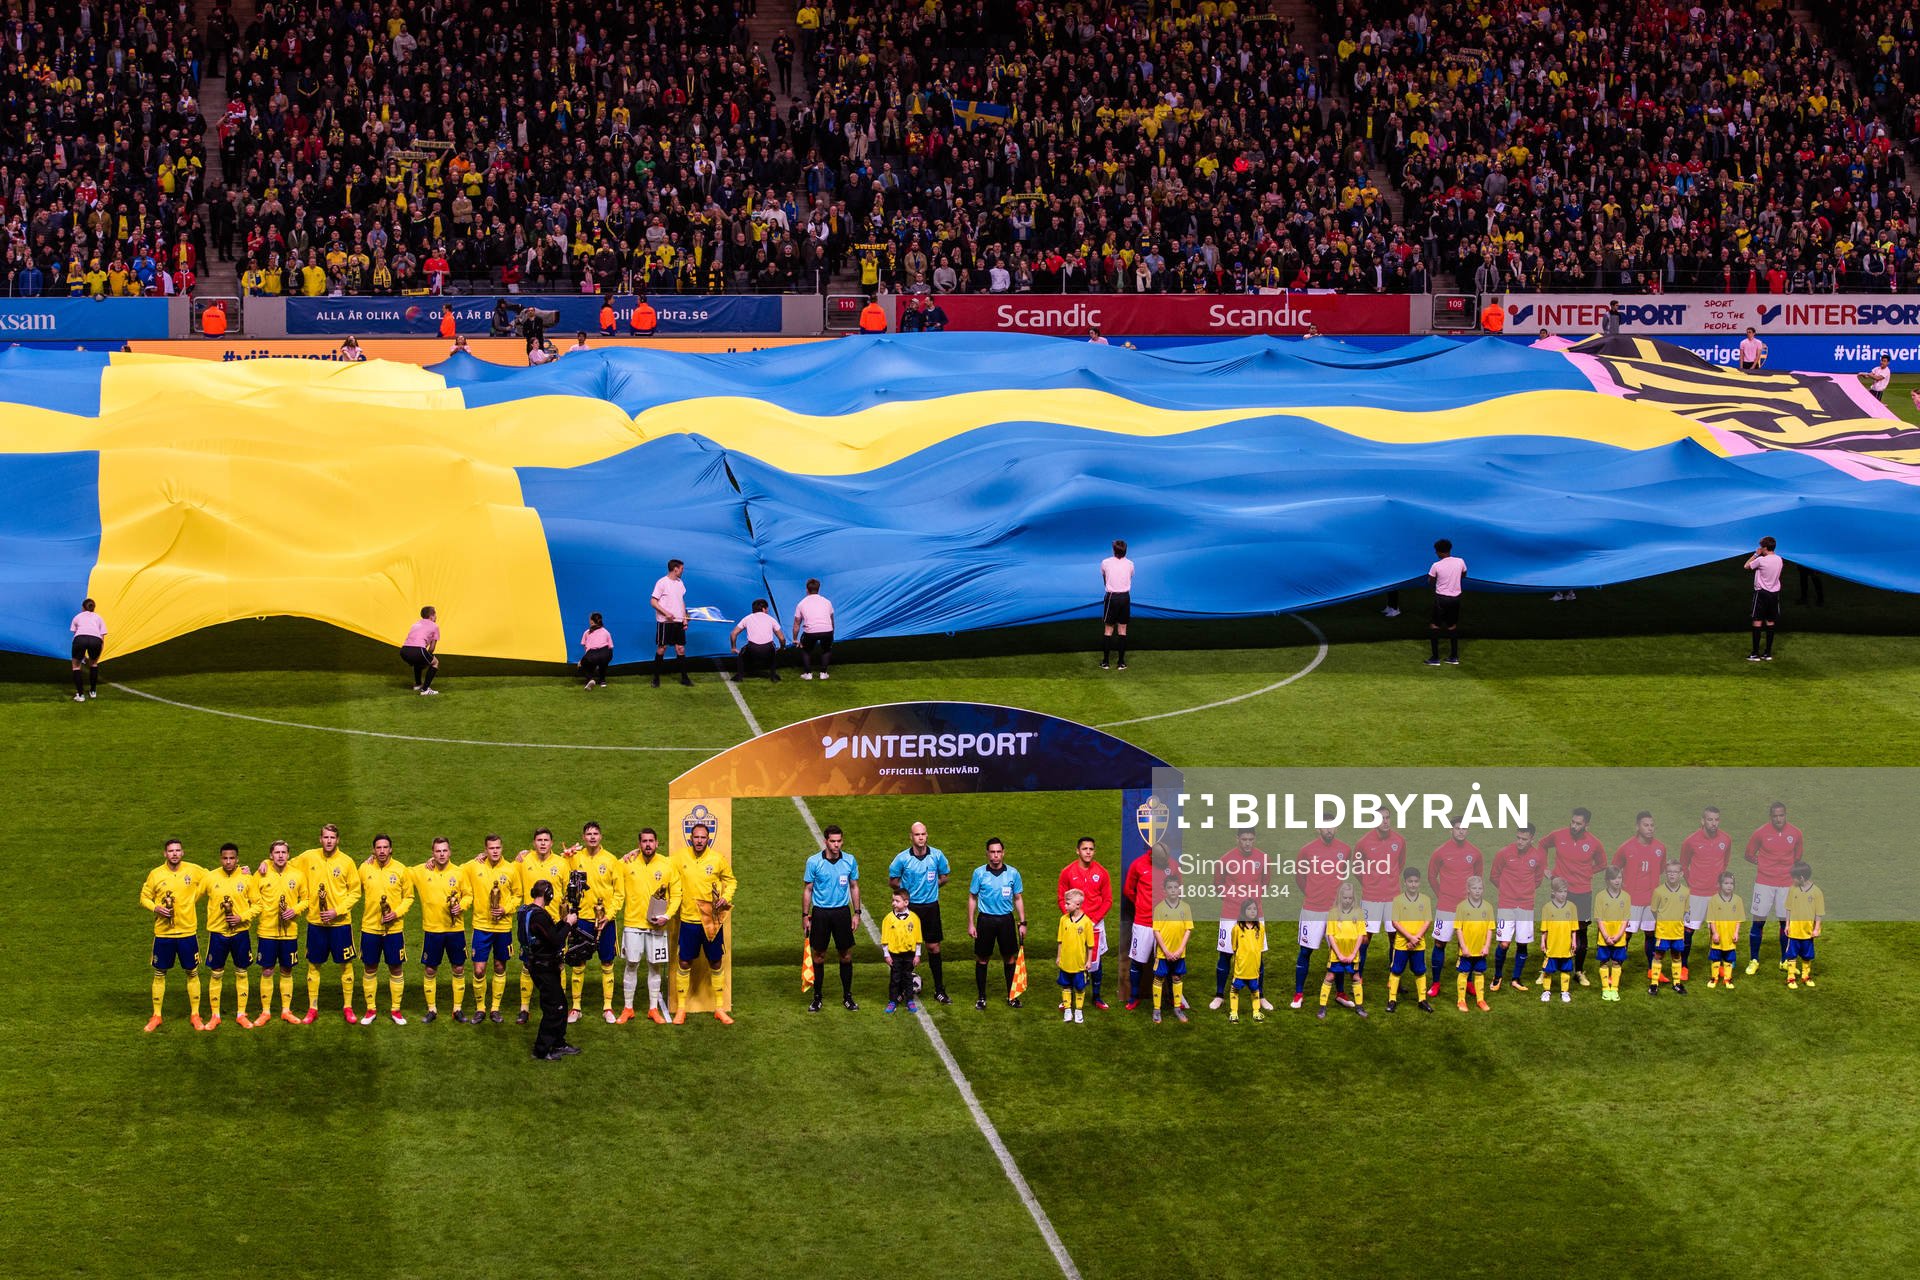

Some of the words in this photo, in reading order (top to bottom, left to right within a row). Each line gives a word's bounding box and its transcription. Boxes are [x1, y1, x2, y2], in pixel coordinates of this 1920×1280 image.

[839, 300, 855, 309] 110
[1449, 300, 1462, 308] 109
[1704, 299, 1735, 308] SPORT
[316, 311, 345, 320] ALLA
[348, 309, 363, 320] ÄR
[366, 311, 400, 320] OLIKA
[429, 311, 463, 320] OLA
[466, 309, 481, 320] ÄR
[997, 303, 1101, 328] Scandic
[1209, 303, 1312, 327] Scandic
[1710, 311, 1724, 319] TO
[1727, 311, 1745, 319] THE
[1704, 322, 1737, 330] PEOPLE
[1691, 344, 1740, 364] erige
[851, 732, 1033, 759] INTERSPORT
[879, 767, 923, 776] OFFICIELL
[925, 765, 980, 775] MATCHVÄRD
[1302, 925, 1308, 936] 6
[655, 947, 667, 960] 23
